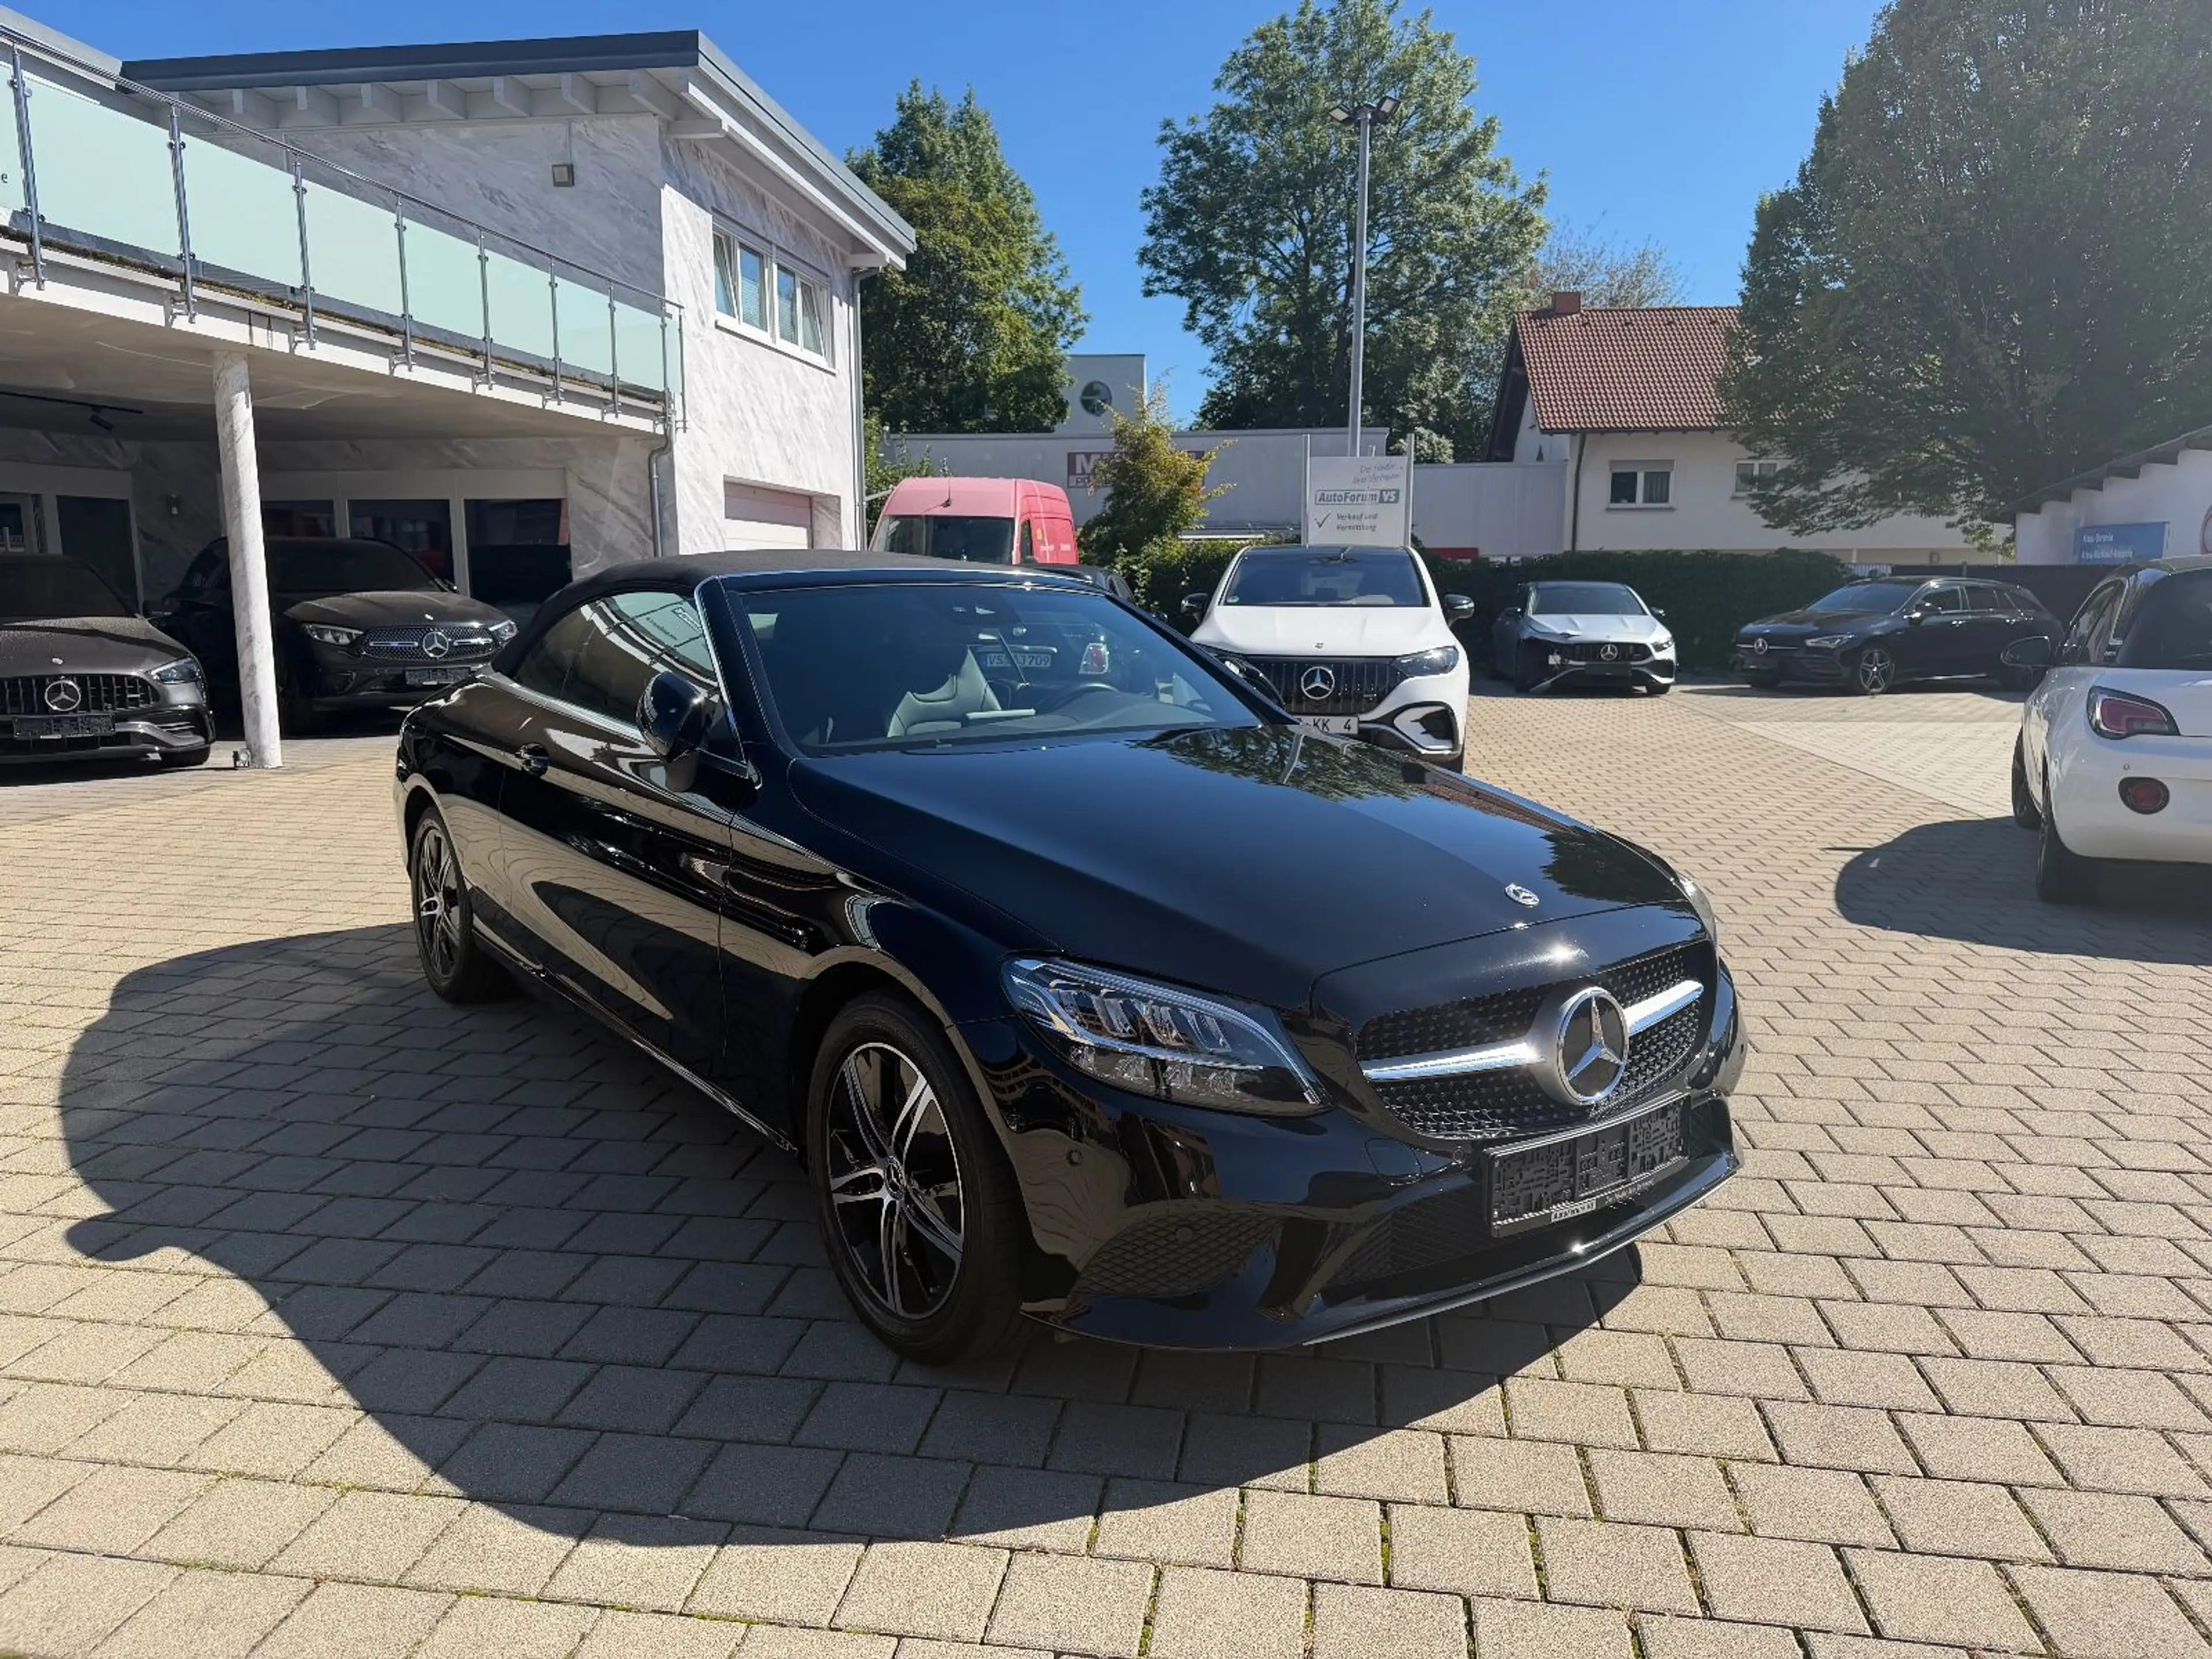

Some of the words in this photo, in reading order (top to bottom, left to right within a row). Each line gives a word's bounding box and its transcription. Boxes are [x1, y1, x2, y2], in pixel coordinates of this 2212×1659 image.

[1319, 491, 1377, 503] AutoForum
[1382, 491, 1396, 502] VS
[989, 655, 1003, 665] VS
[1343, 718, 1352, 732] 4
